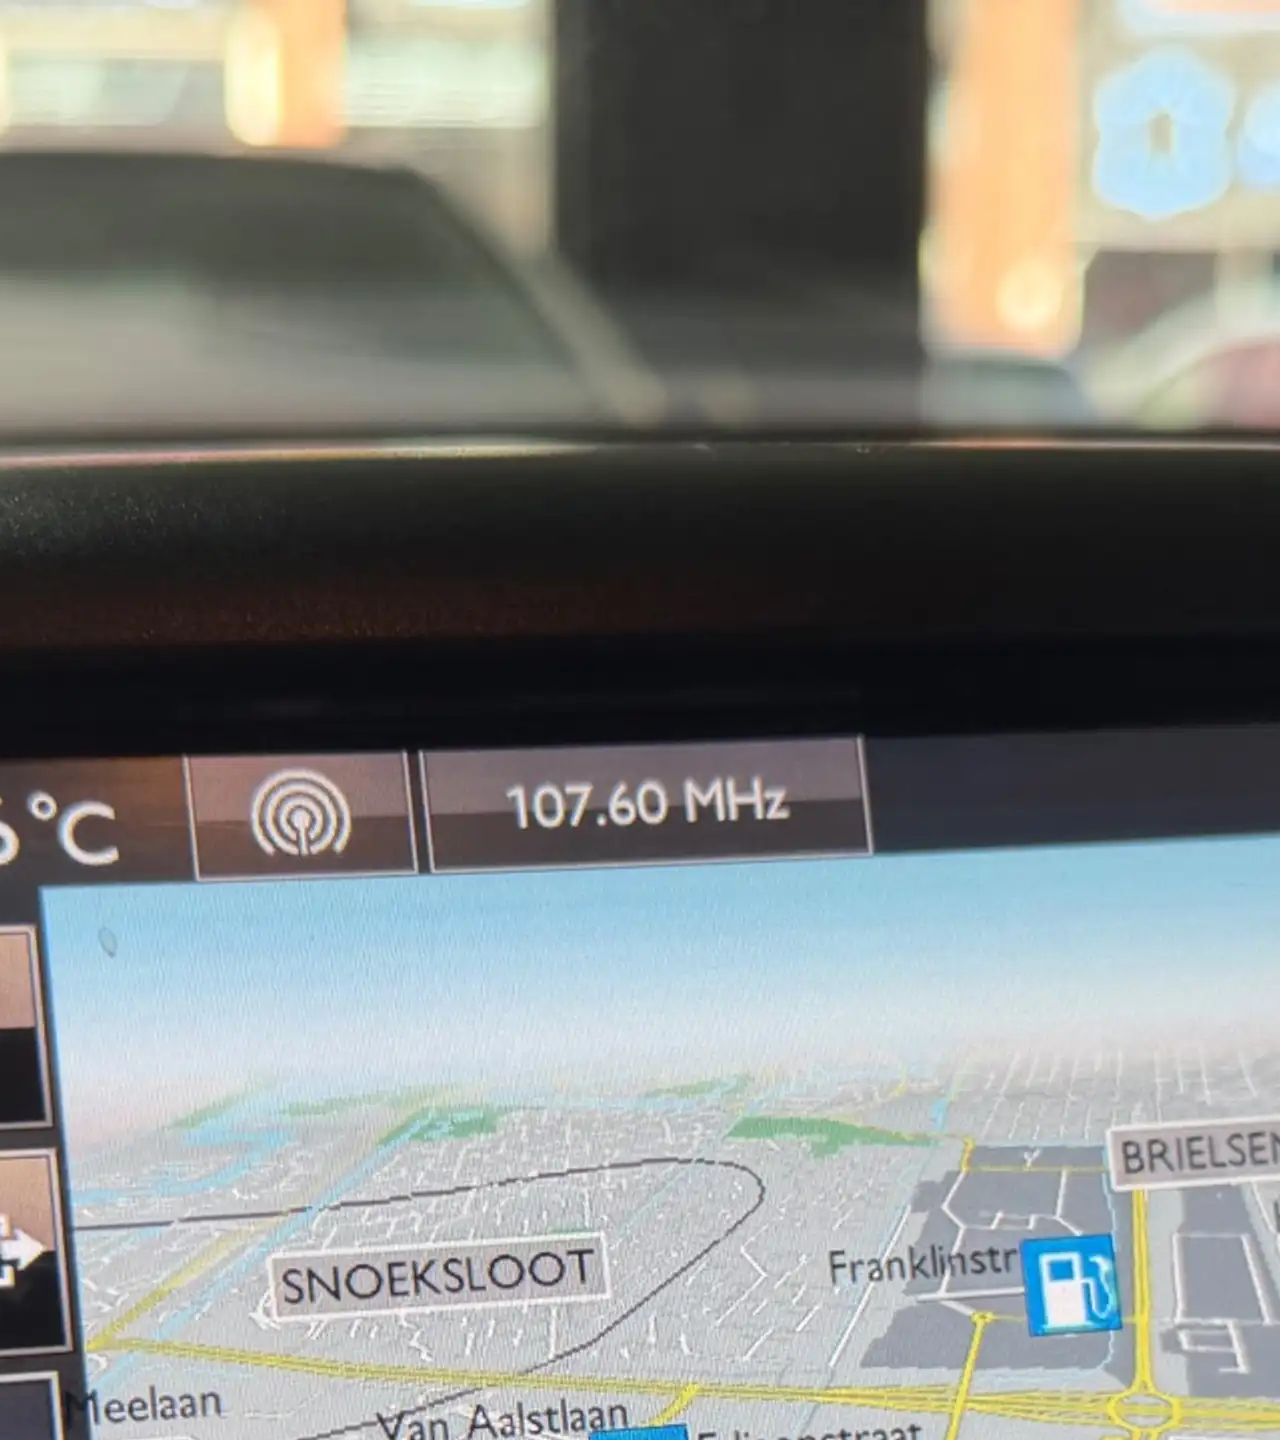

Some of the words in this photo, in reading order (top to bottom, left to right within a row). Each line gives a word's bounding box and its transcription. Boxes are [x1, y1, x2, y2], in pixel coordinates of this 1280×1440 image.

[506, 780, 669, 830] 107.60
[684, 777, 790, 823] MHz
[282, 1249, 594, 1305] SNOEKSLOOT
[467, 1399, 627, 1437] Aalstlaan
